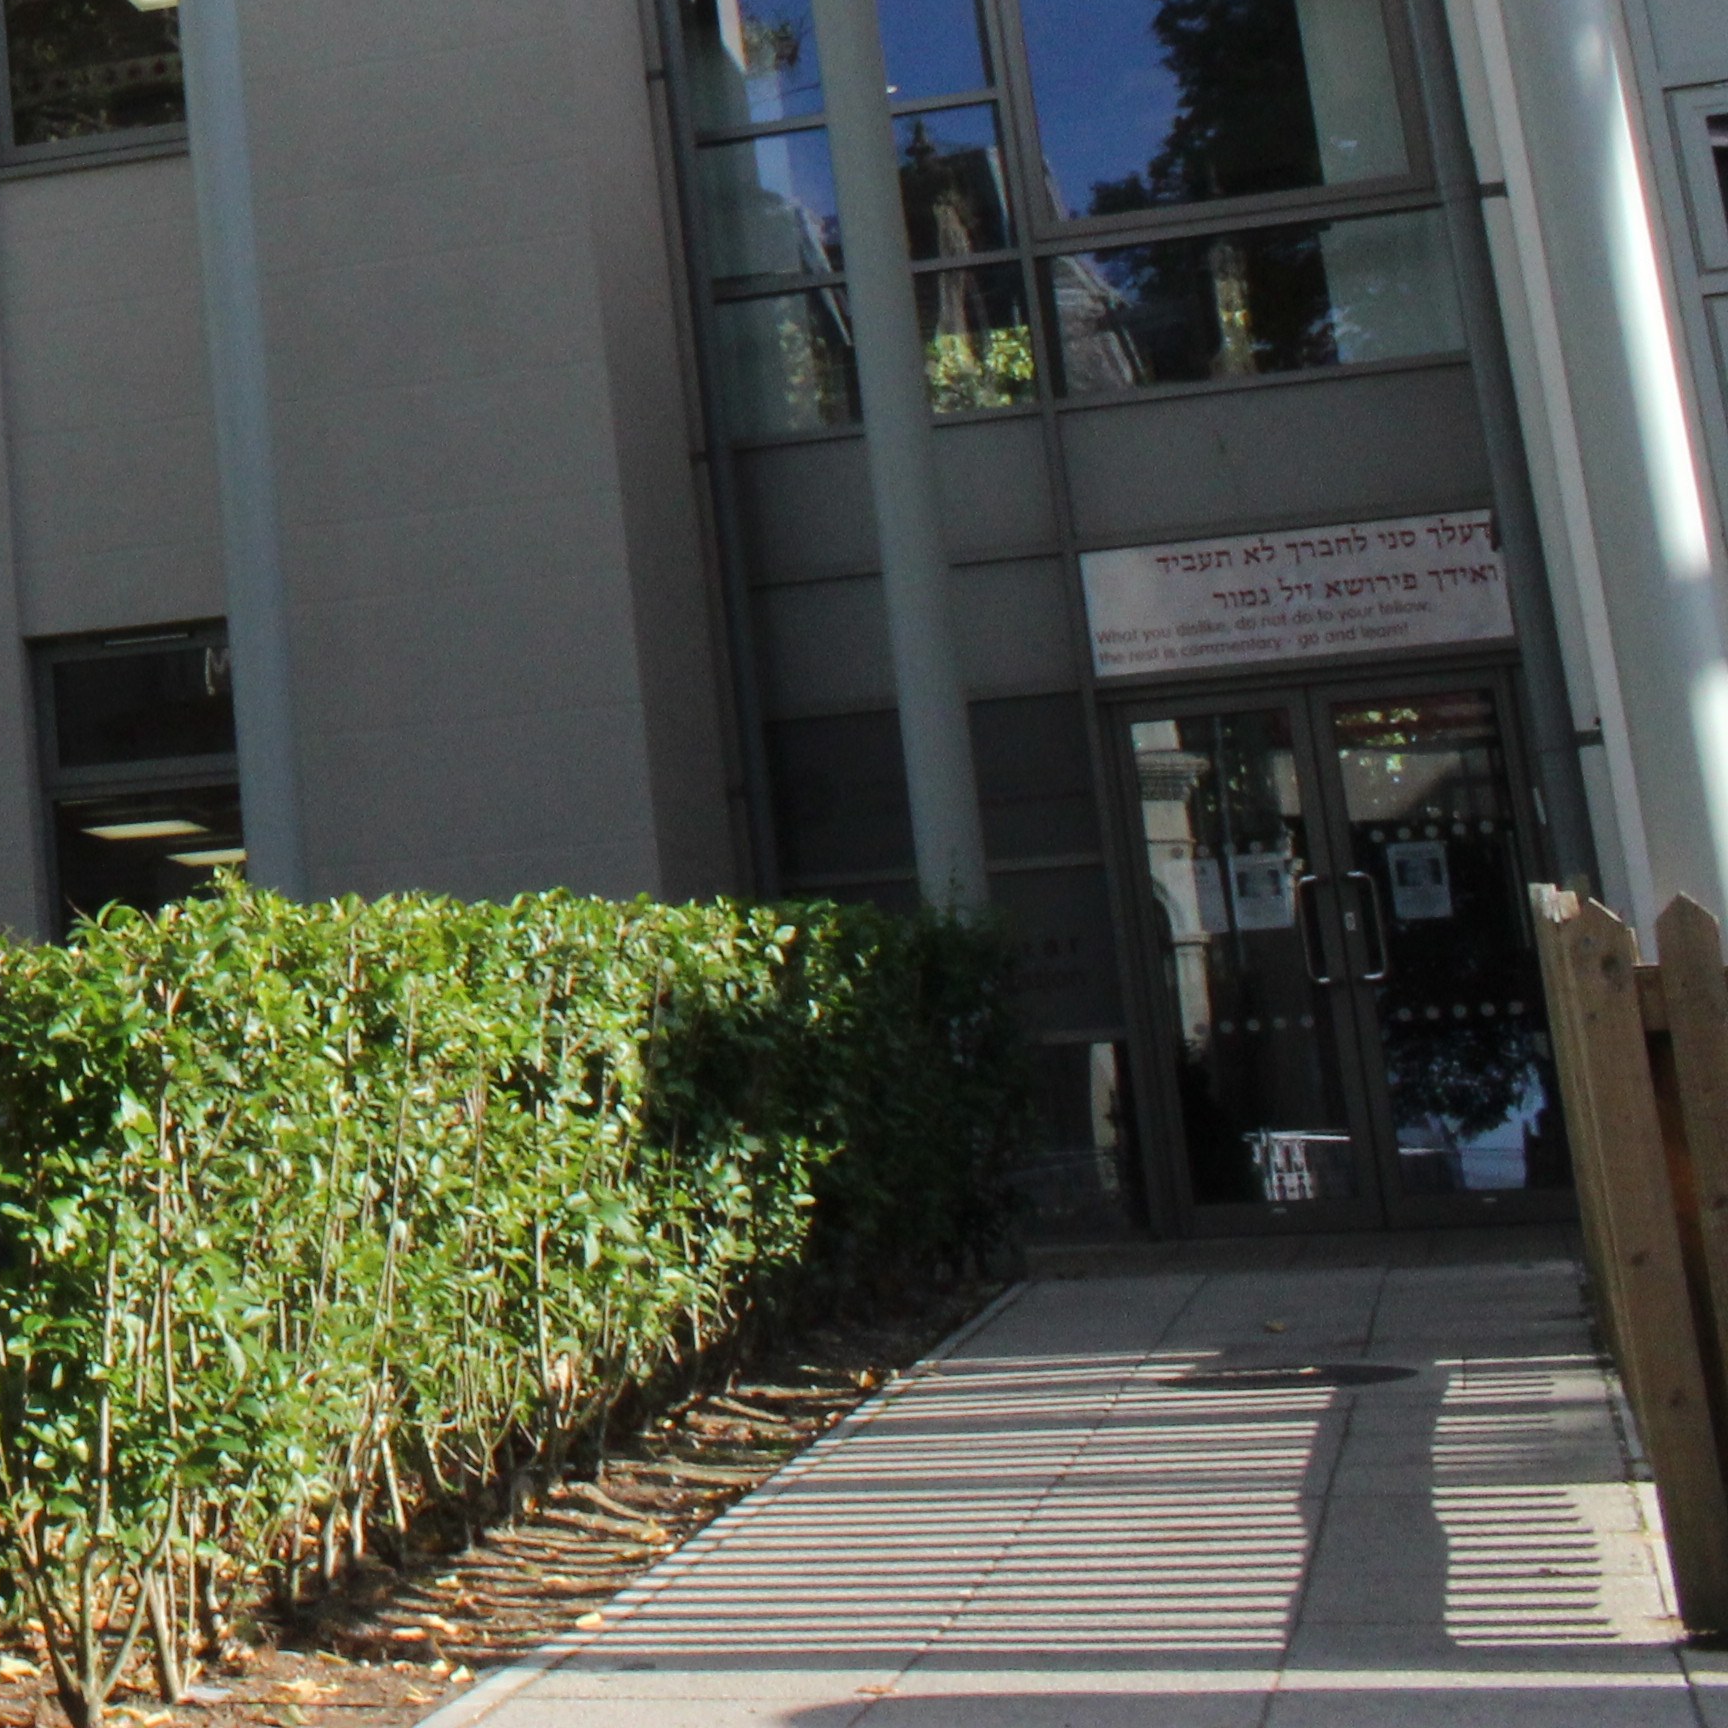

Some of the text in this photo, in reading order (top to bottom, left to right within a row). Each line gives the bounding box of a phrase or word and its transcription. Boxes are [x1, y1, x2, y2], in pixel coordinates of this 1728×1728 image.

[1240, 536, 1276, 565] לא
[1291, 609, 1313, 624] do
[1316, 608, 1333, 622] to
[1338, 605, 1373, 622] your
[1296, 632, 1320, 649] go
[1323, 627, 1356, 642] and
